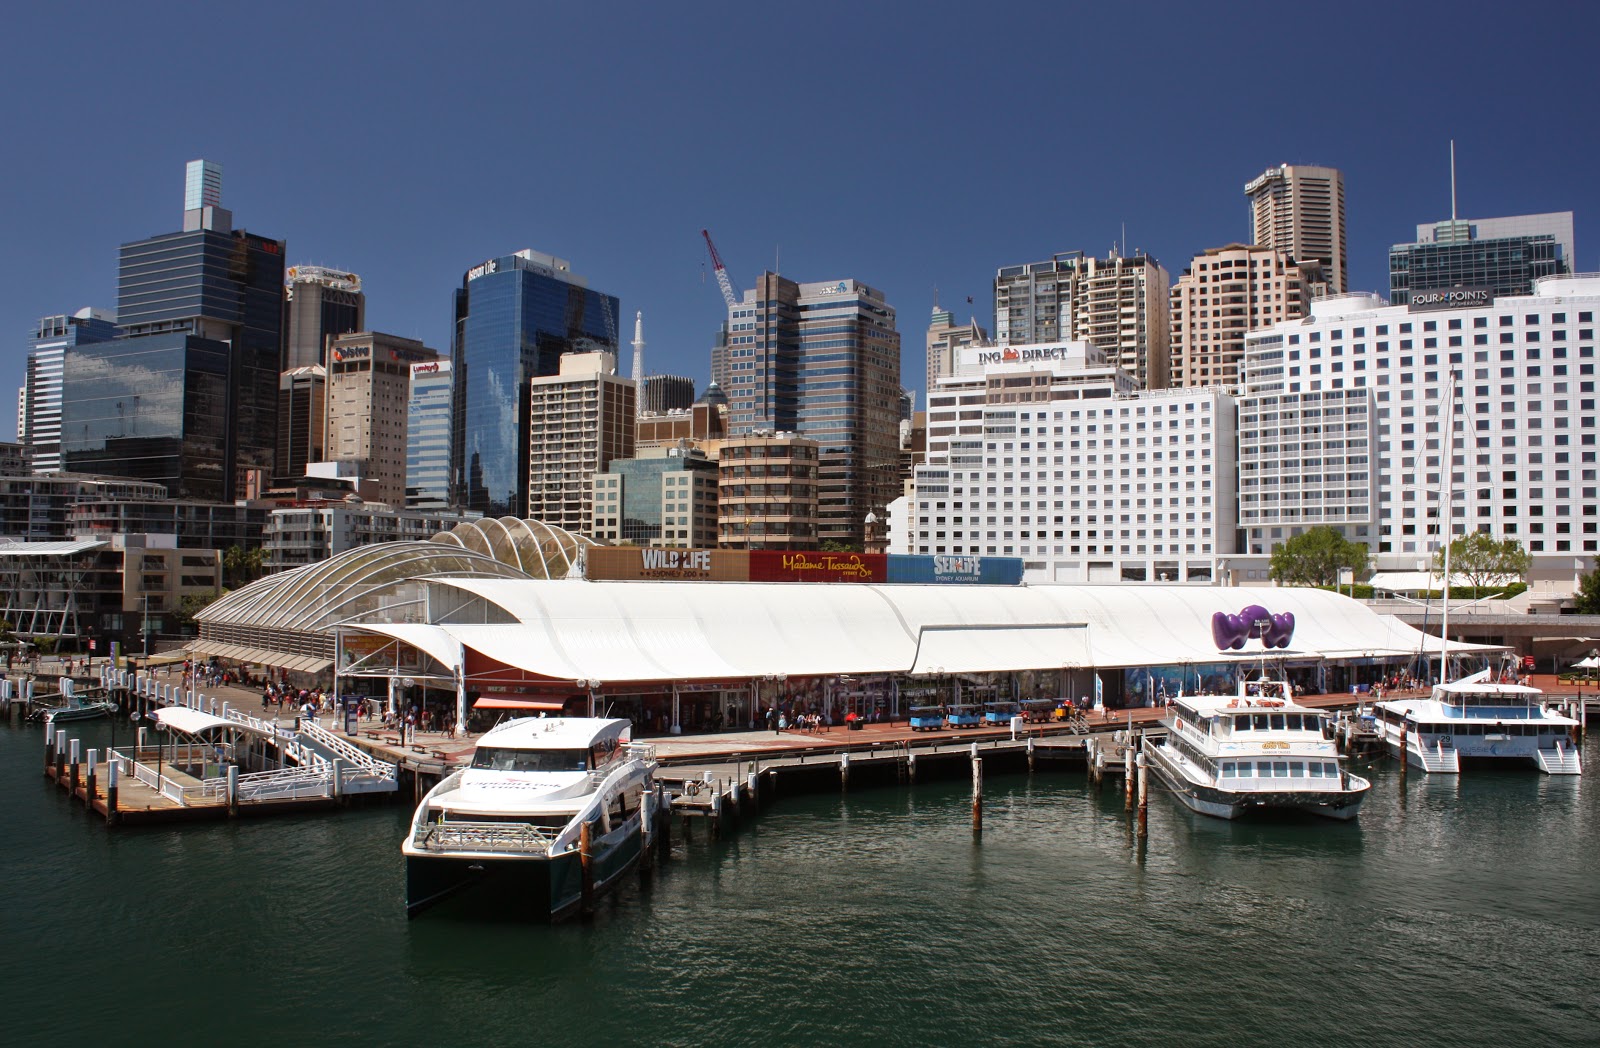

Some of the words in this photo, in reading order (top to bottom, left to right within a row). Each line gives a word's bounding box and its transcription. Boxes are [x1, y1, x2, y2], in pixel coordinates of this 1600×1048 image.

[485, 259, 496, 275] Life
[819, 286, 837, 295] ANZ
[1412, 293, 1439, 305] FOUR
[1449, 290, 1488, 301] POINTS
[334, 346, 369, 361] Telstra
[979, 352, 1001, 364] ING
[1022, 348, 1067, 360] DIRECT
[642, 549, 679, 569] WILD
[682, 550, 711, 570] LIFE
[783, 554, 824, 571] Madame
[821, 555, 868, 577] Tussauds
[934, 555, 957, 575] SEA
[1441, 735, 1451, 743] 29
